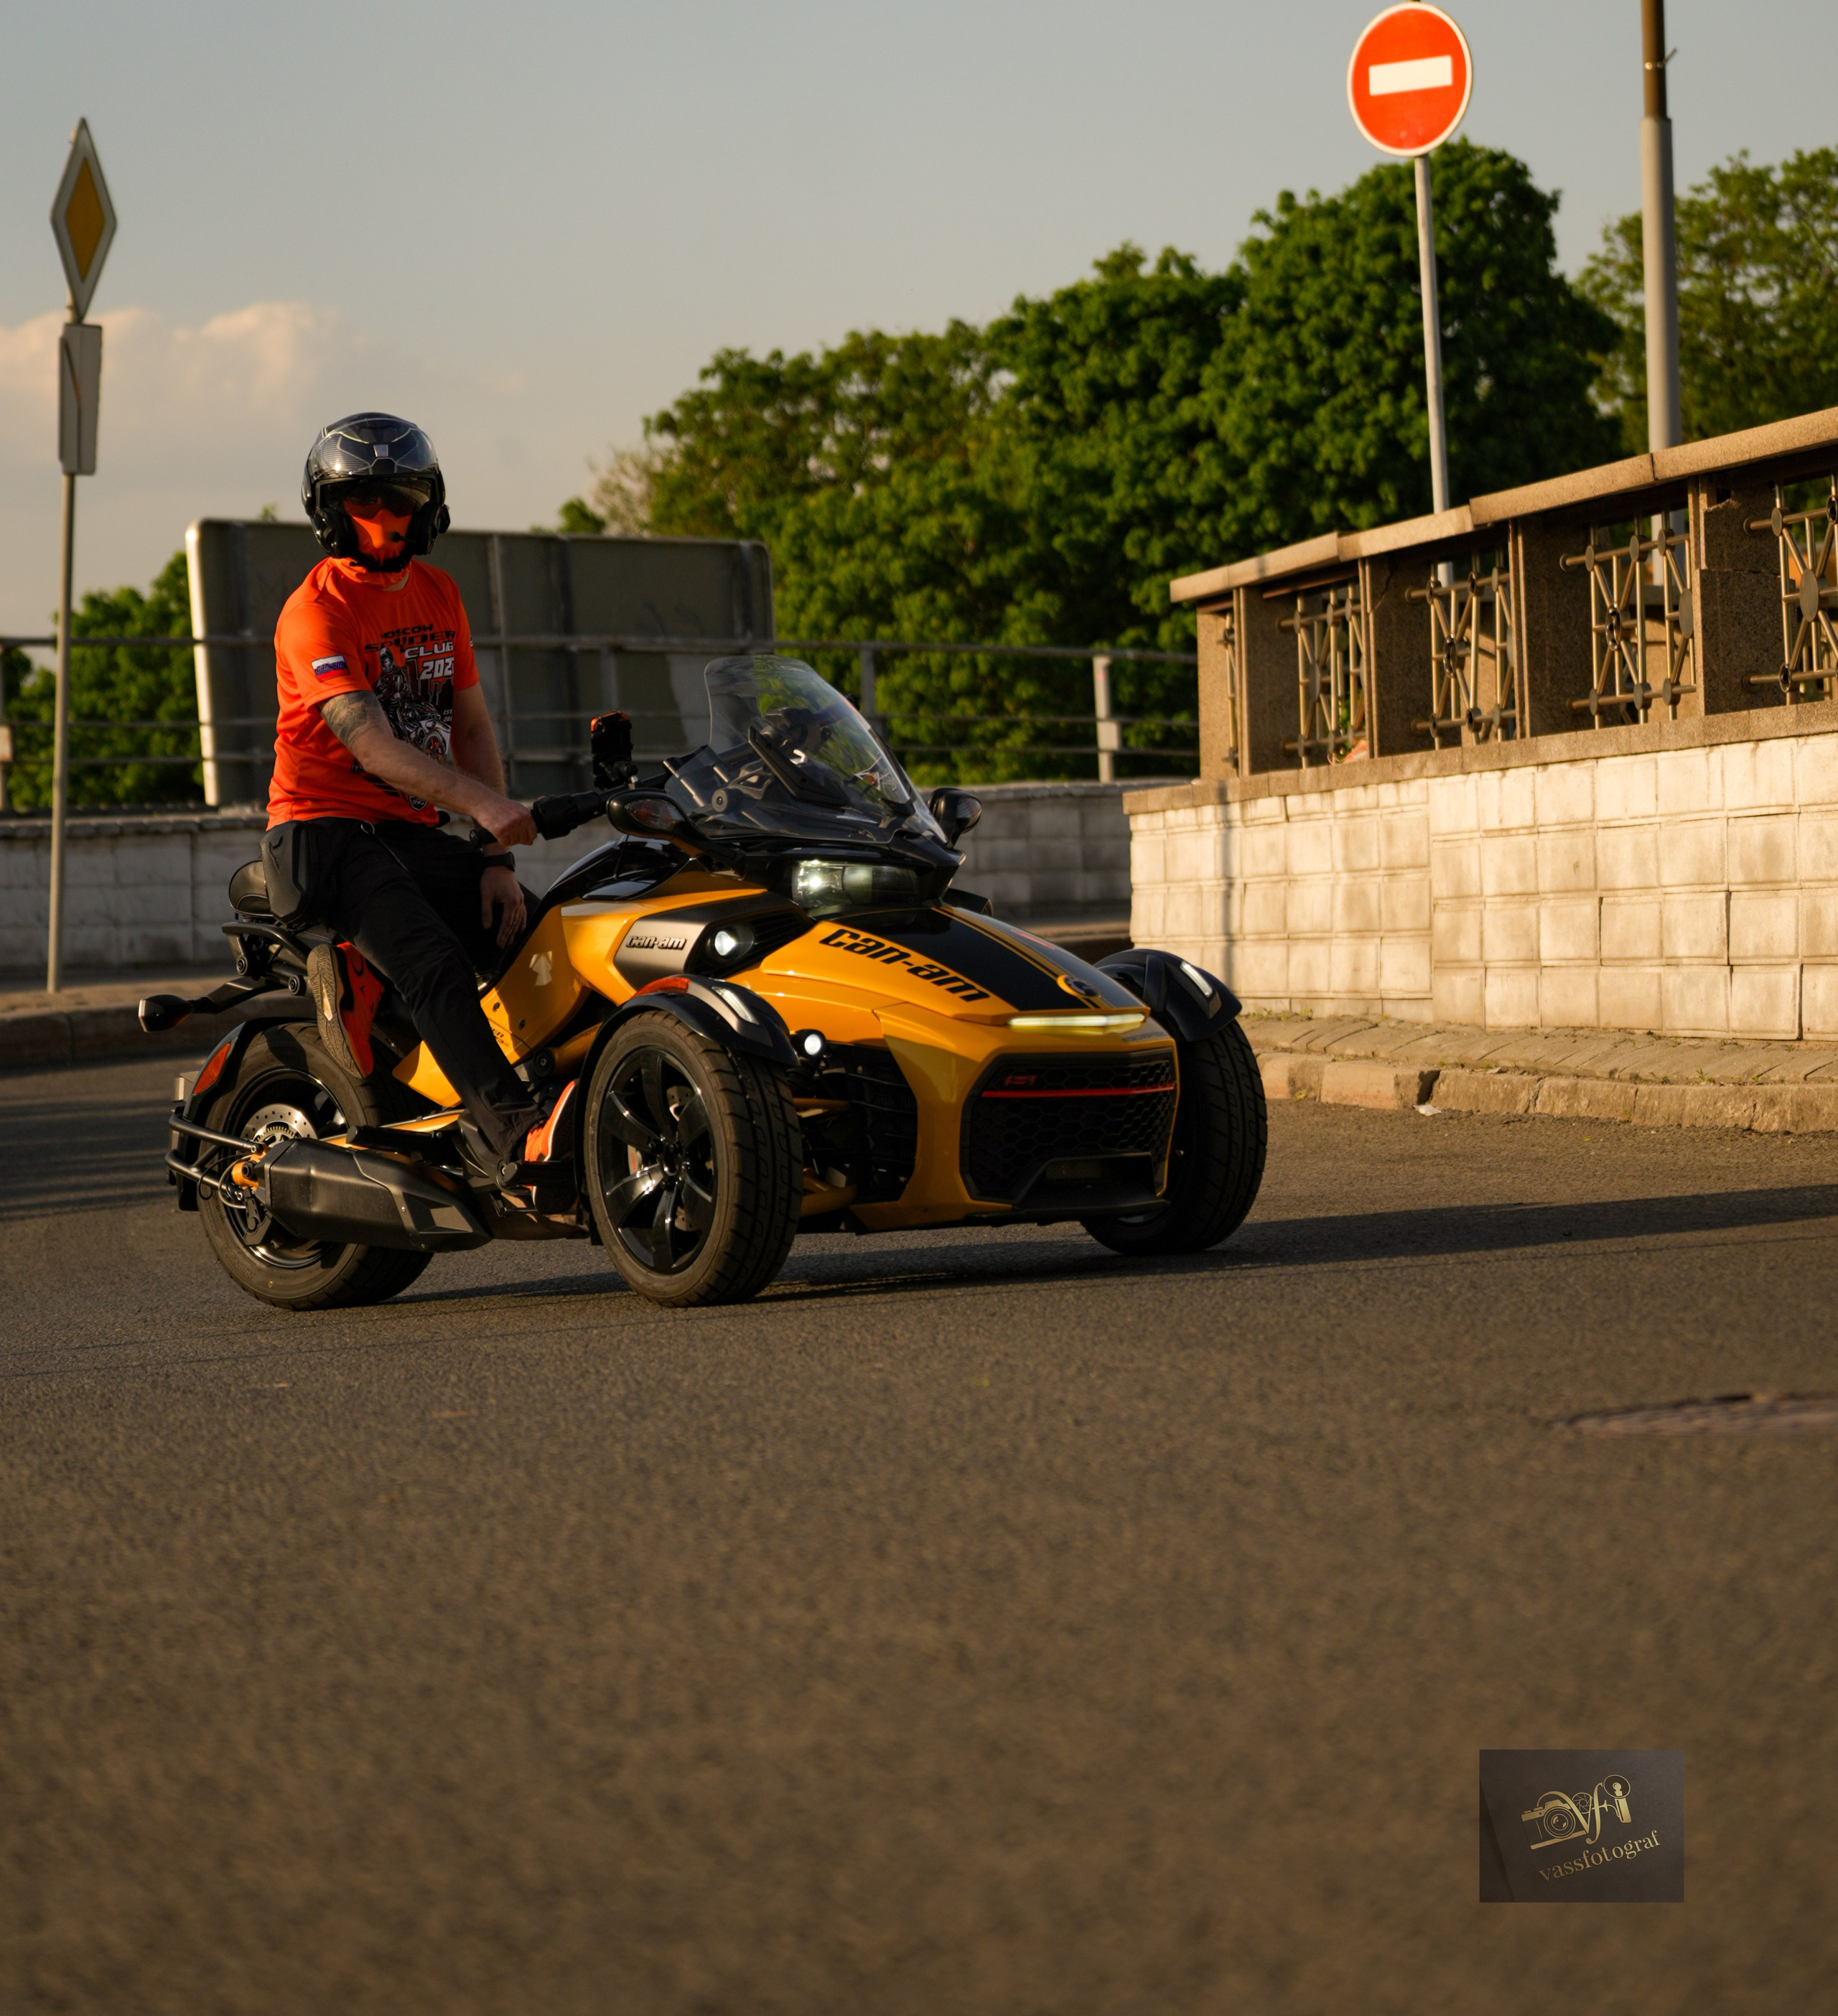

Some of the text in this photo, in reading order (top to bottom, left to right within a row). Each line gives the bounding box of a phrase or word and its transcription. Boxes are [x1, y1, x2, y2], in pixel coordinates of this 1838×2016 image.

[380, 623, 434, 639] MOSCOW
[419, 655, 454, 681] 202
[625, 935, 687, 951] can-am
[818, 928, 992, 1003] can-am
